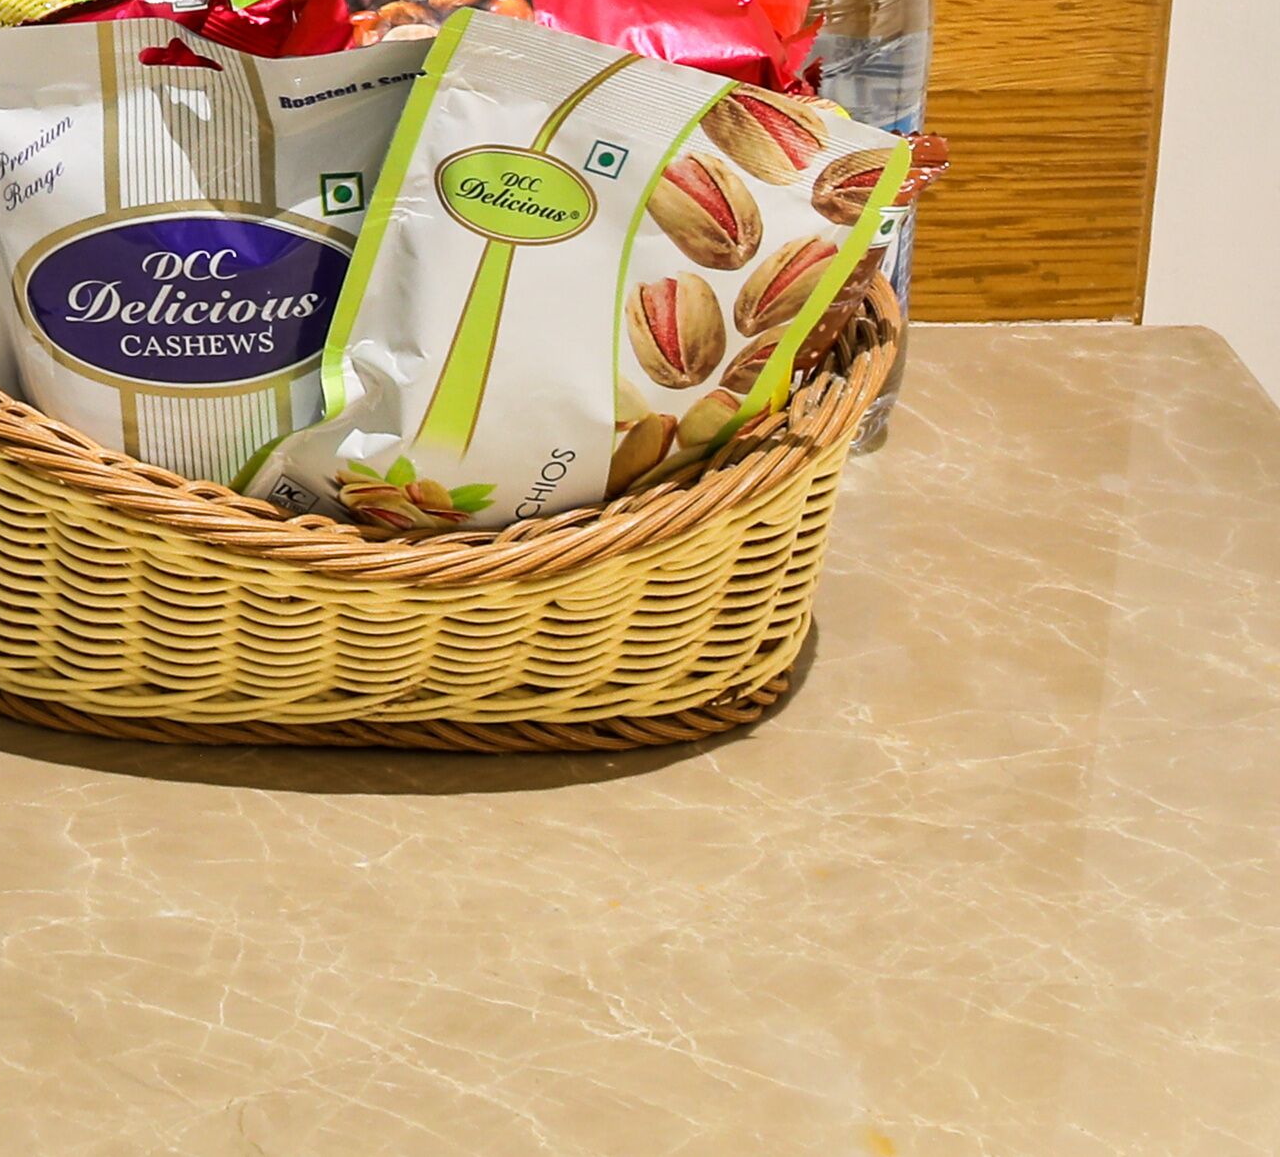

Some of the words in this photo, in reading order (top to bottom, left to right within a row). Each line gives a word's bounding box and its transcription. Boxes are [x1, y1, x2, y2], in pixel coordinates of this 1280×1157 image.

[278, 83, 358, 109] Roasted
[3, 161, 65, 211] Range
[500, 172, 543, 193] DCC
[455, 177, 569, 222] Delicious
[142, 249, 238, 281] DCC
[65, 280, 320, 325] Delicious
[120, 332, 276, 358] CASHEWS
